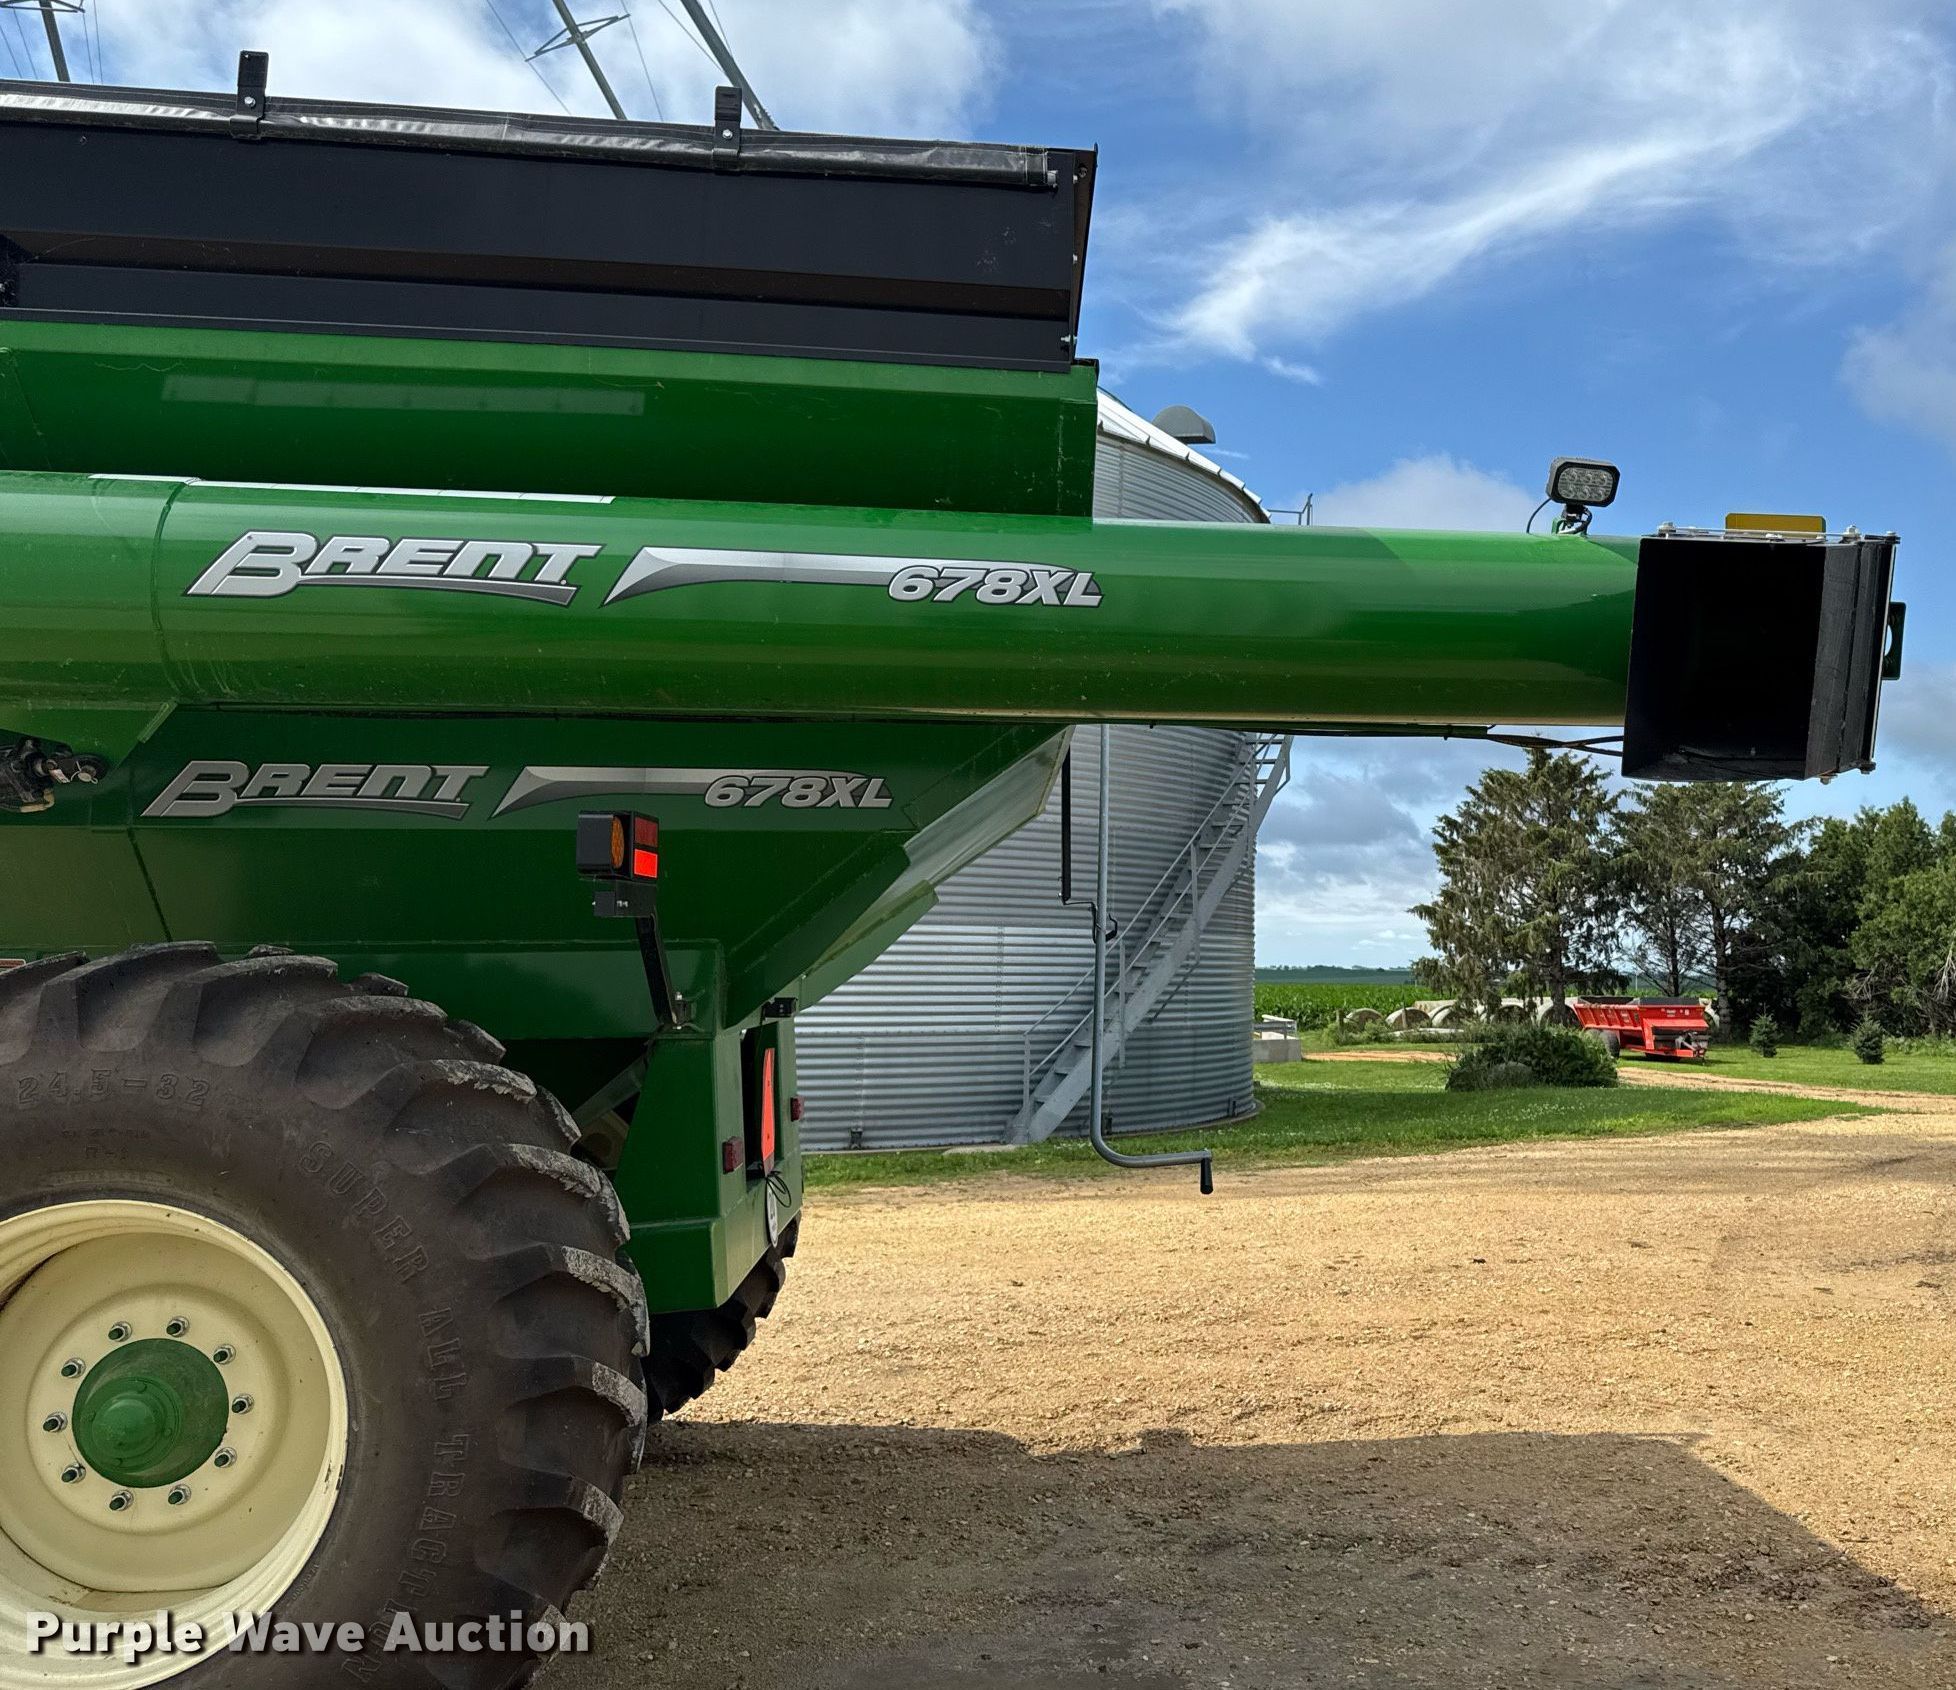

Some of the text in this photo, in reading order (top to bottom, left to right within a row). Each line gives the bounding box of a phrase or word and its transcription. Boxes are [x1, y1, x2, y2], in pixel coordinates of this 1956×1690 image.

[183, 530, 1104, 607] BRENT 678XL
[140, 761, 893, 816] BRENT 678XL
[17, 1067, 211, 1108] 24.5-32
[299, 1140, 430, 1285] SUPER
[417, 1306, 468, 1402] ALL
